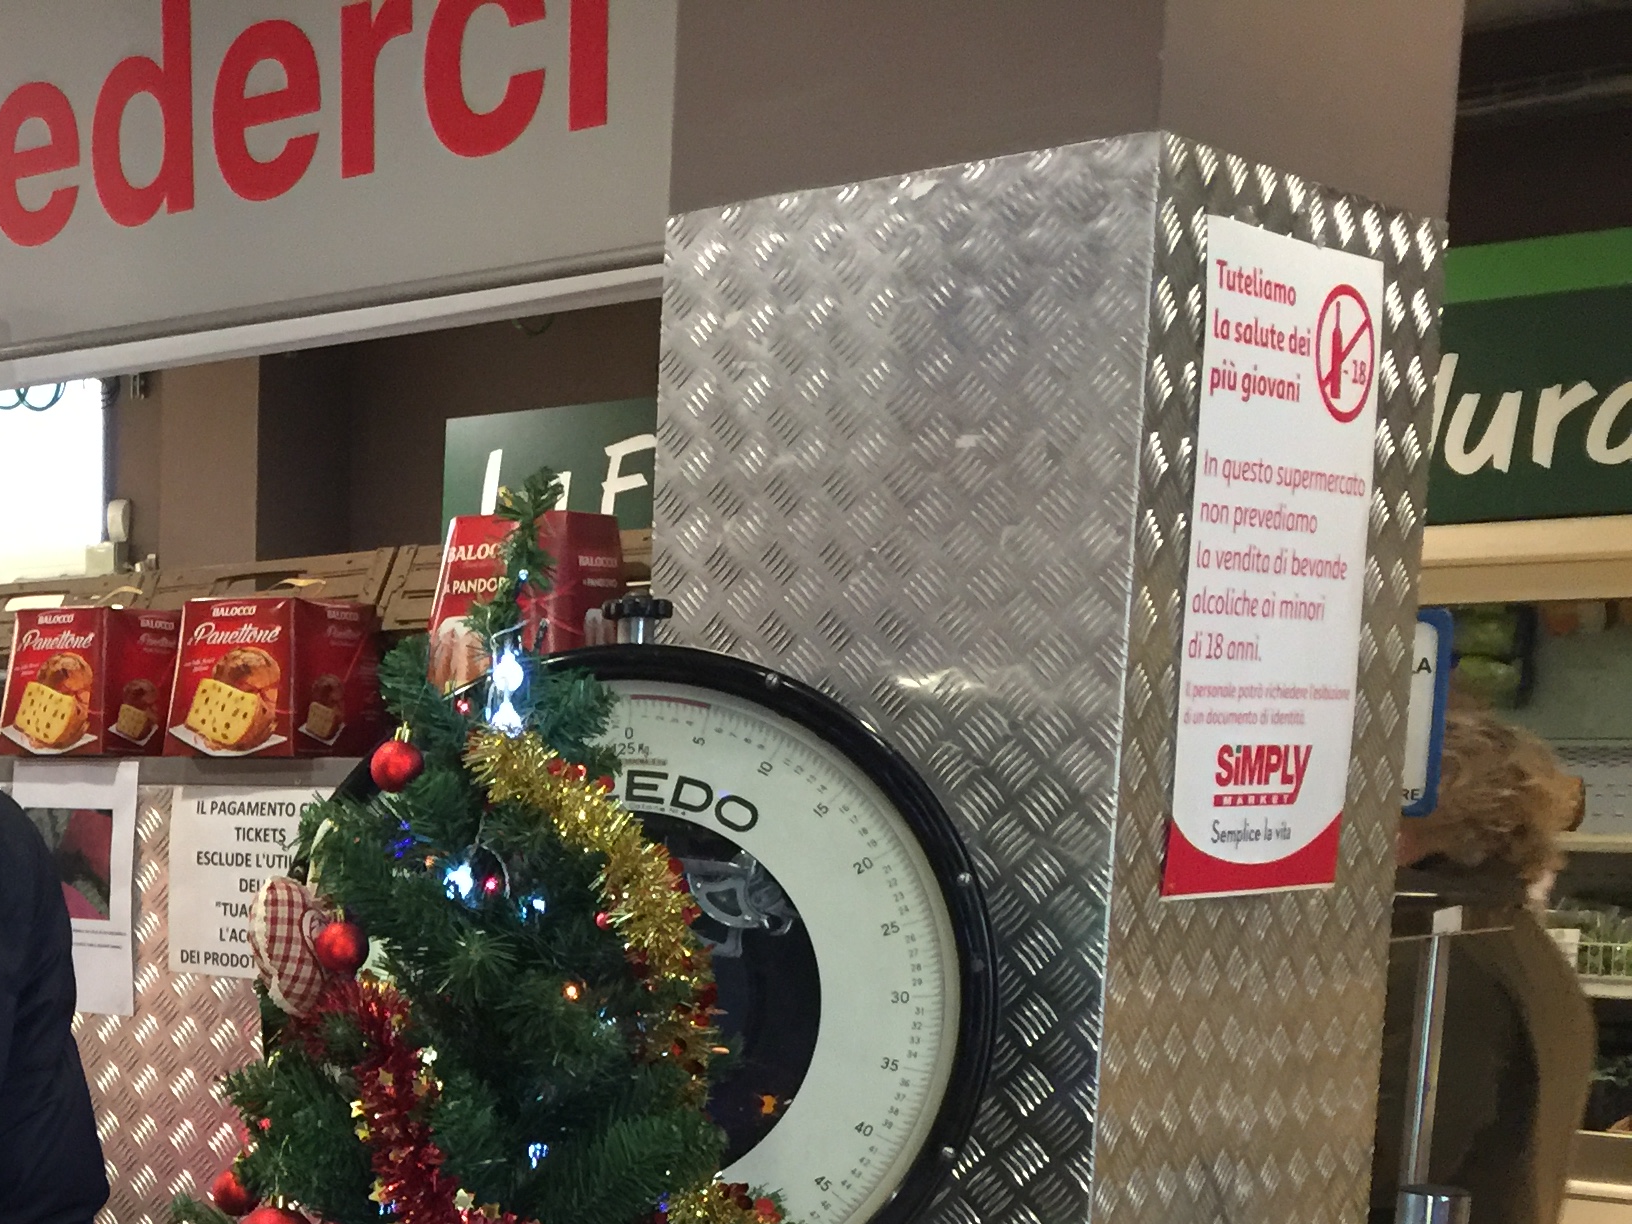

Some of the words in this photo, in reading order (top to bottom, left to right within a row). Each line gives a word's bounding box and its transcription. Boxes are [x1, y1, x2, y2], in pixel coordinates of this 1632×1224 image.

[1216, 259, 1297, 306] Tuteliamo
[1213, 308, 1230, 340] la
[1234, 317, 1285, 351] salute
[1288, 326, 1311, 357] dei
[1210, 359, 1237, 396] più
[1241, 364, 1301, 402] giovani
[1203, 450, 1218, 477] In
[1222, 458, 1273, 487] questo
[1276, 464, 1366, 497] supermercato
[1200, 502, 1229, 525] non
[1233, 503, 1318, 534] prevediamo
[1196, 540, 1210, 569] la
[1215, 544, 1269, 574] vendita
[1273, 547, 1288, 575] di
[1291, 549, 1348, 580] bevande
[212, 605, 257, 617] BALOCCO
[1192, 586, 1257, 618] alcoliche
[1261, 591, 1276, 618] ai
[1280, 593, 1325, 621] minori
[37, 613, 75, 625] BALOCCO
[22, 628, 95, 651] Panettone
[193, 621, 282, 646] Panettone
[1188, 630, 1203, 659] di
[1205, 632, 1224, 660] 18
[1227, 635, 1262, 662] anni.
[1193, 682, 1236, 703] personale
[1206, 708, 1257, 725] documento
[692, 736, 706, 746] 5
[757, 760, 773, 777] 10
[608, 769, 759, 833] EDO
[1223, 794, 1290, 806] MARKET
[196, 801, 207, 815] IL
[210, 801, 296, 817] PAGAMENTO
[813, 802, 829, 818] 15
[234, 827, 286, 843] TICKETS
[1211, 818, 1261, 849] Semplice
[1263, 817, 1272, 841] la
[1276, 821, 1291, 841] vita
[196, 851, 252, 867] ESCLUDE
[852, 857, 874, 875] 20
[880, 920, 900, 937] 25
[180, 949, 200, 964] DEI
[891, 990, 910, 1004] 30
[880, 1057, 899, 1072] 35
[854, 1121, 874, 1137] 40
[814, 1175, 833, 1192] 45
